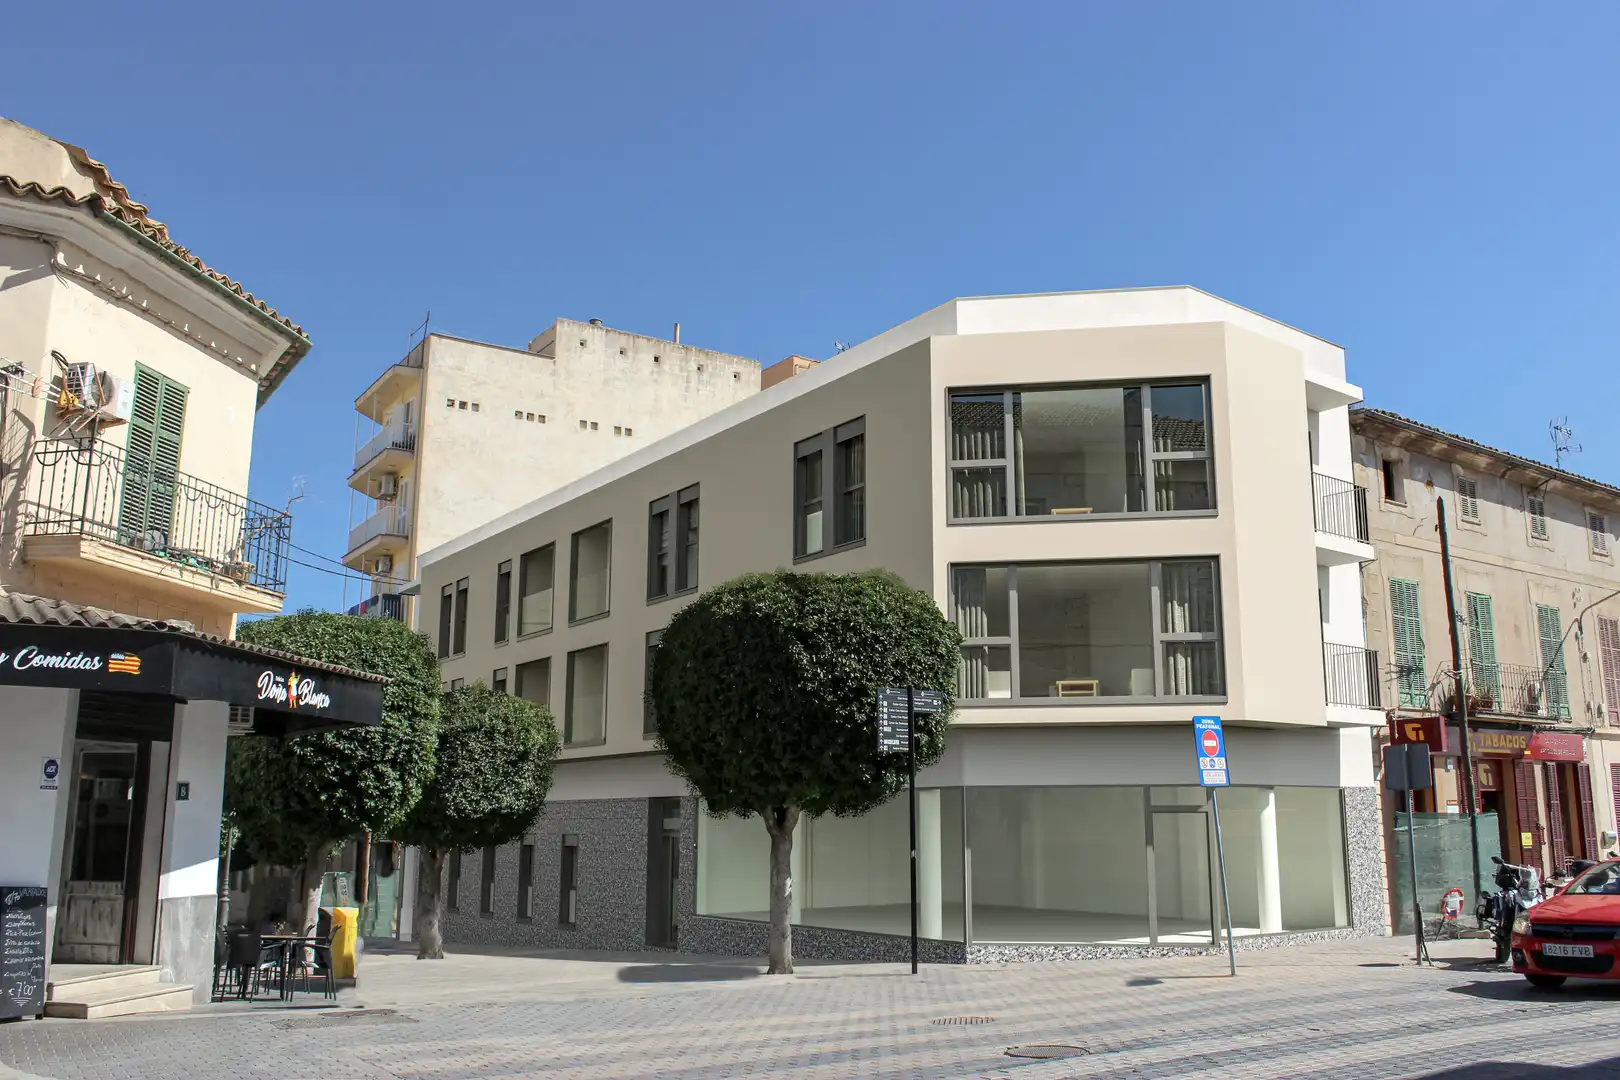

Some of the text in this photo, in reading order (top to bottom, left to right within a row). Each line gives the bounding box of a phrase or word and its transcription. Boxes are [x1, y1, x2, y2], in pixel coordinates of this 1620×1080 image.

[13, 645, 103, 670] Comidas
[257, 670, 331, 709] Doña Blanca
[1480, 733, 1526, 749] TABACOS
[1547, 944, 1591, 956] 8216 FVB
